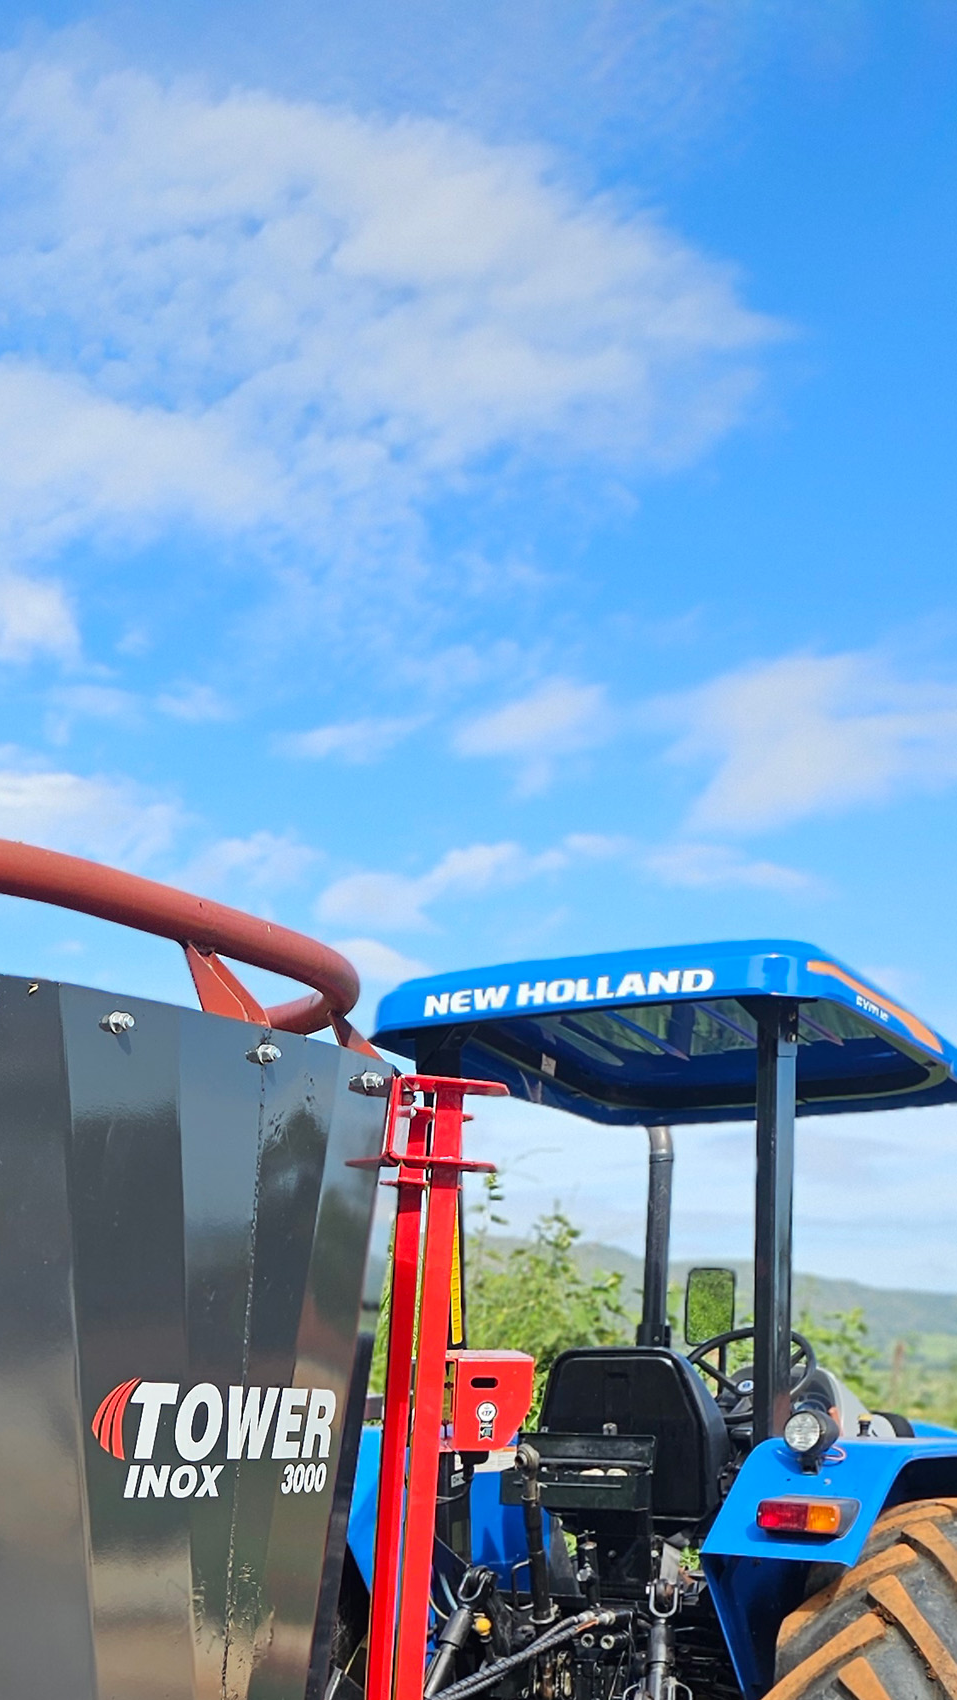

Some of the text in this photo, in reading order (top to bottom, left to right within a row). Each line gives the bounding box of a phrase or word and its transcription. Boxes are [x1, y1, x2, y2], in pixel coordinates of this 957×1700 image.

[424, 969, 714, 1016] NEW HOLLAND
[130, 1382, 337, 1462] TOWER
[123, 1463, 327, 1498] INOX 3000
